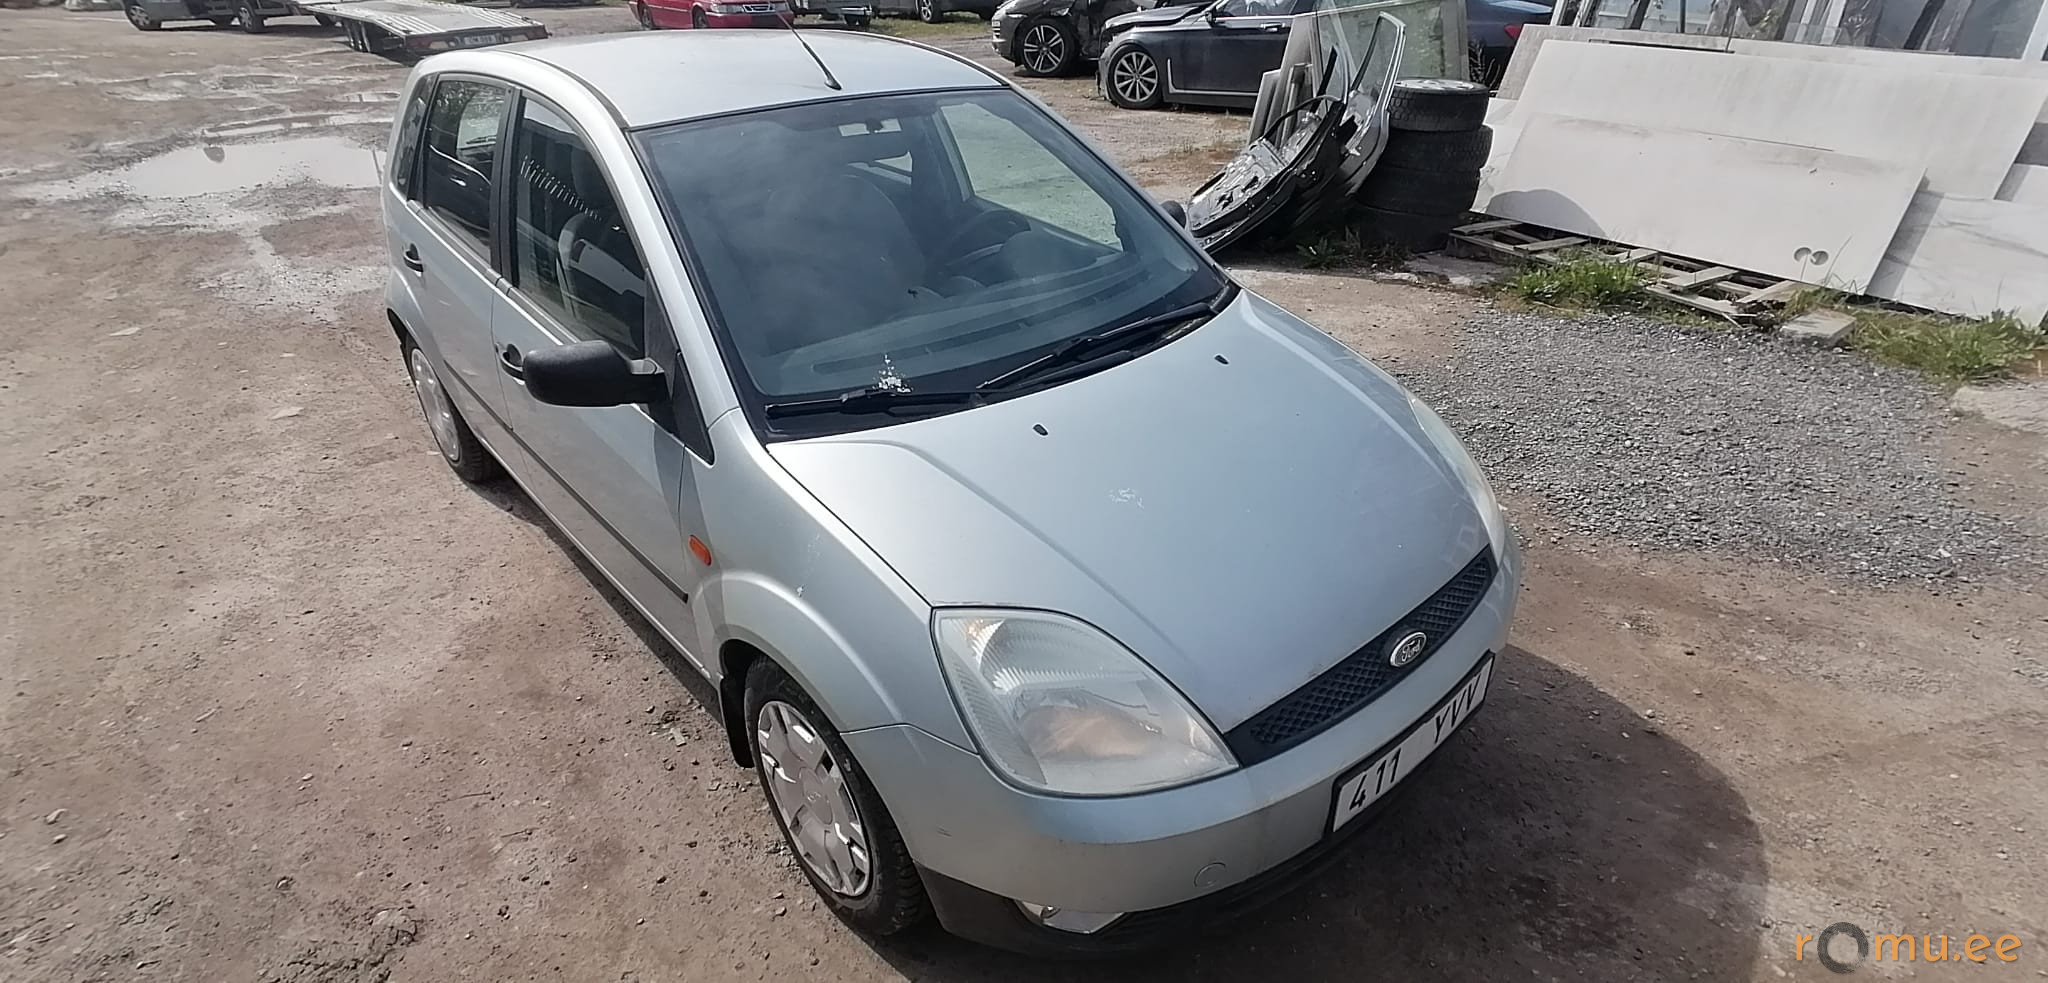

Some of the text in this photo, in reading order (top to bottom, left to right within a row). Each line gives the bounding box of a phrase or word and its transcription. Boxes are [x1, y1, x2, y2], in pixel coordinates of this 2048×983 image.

[1400, 638, 1422, 662] Ford
[1349, 673, 1482, 811] 411 YVV
